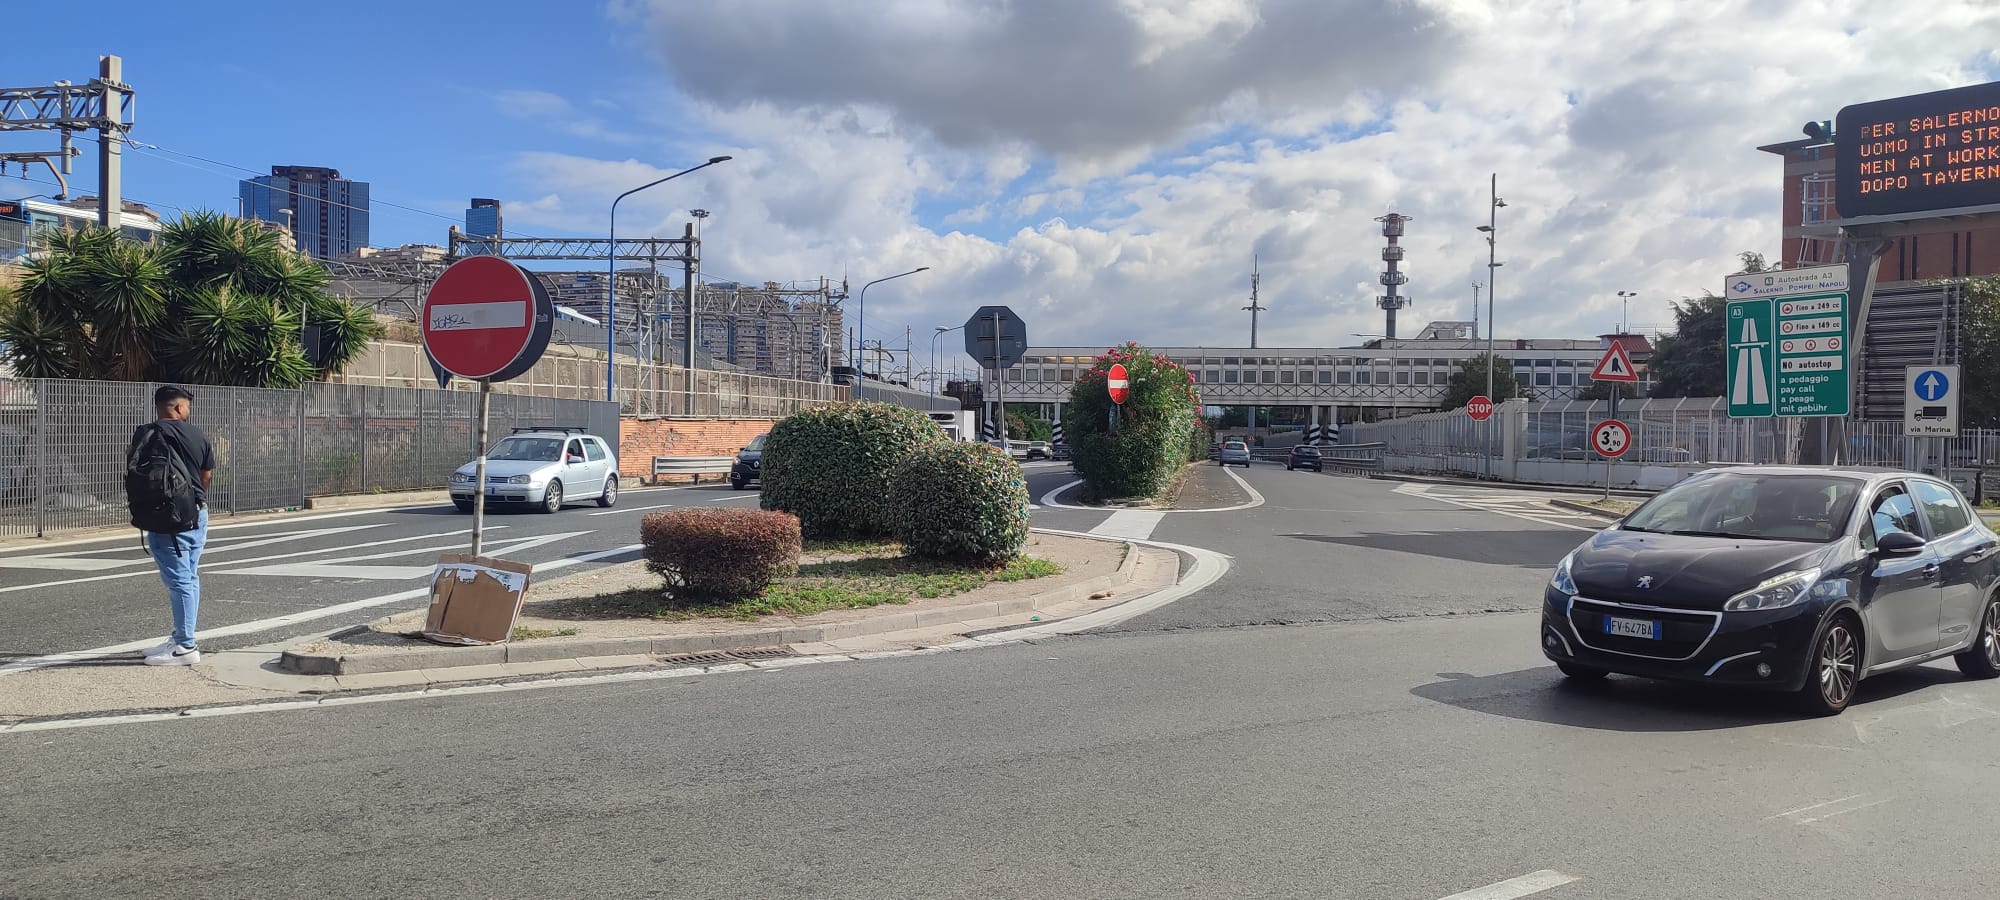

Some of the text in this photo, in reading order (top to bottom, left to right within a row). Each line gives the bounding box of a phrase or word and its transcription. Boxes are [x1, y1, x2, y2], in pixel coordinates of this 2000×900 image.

[1861, 107, 2000, 139] PER SALERNO
[1861, 126, 2000, 157] UOMO IN STR
[1861, 146, 2000, 175] MEN AT WORK
[1861, 176, 1908, 194] DOPO
[1778, 274, 1818, 283] Autostrada
[1782, 360, 1832, 369] NO autostop
[1789, 375, 1829, 384] pedaggio
[1781, 385, 1815, 394] pay call
[1469, 404, 1491, 413] STOP
[1781, 404, 1828, 414] mit gebühr
[1601, 431, 1610, 445] 3
